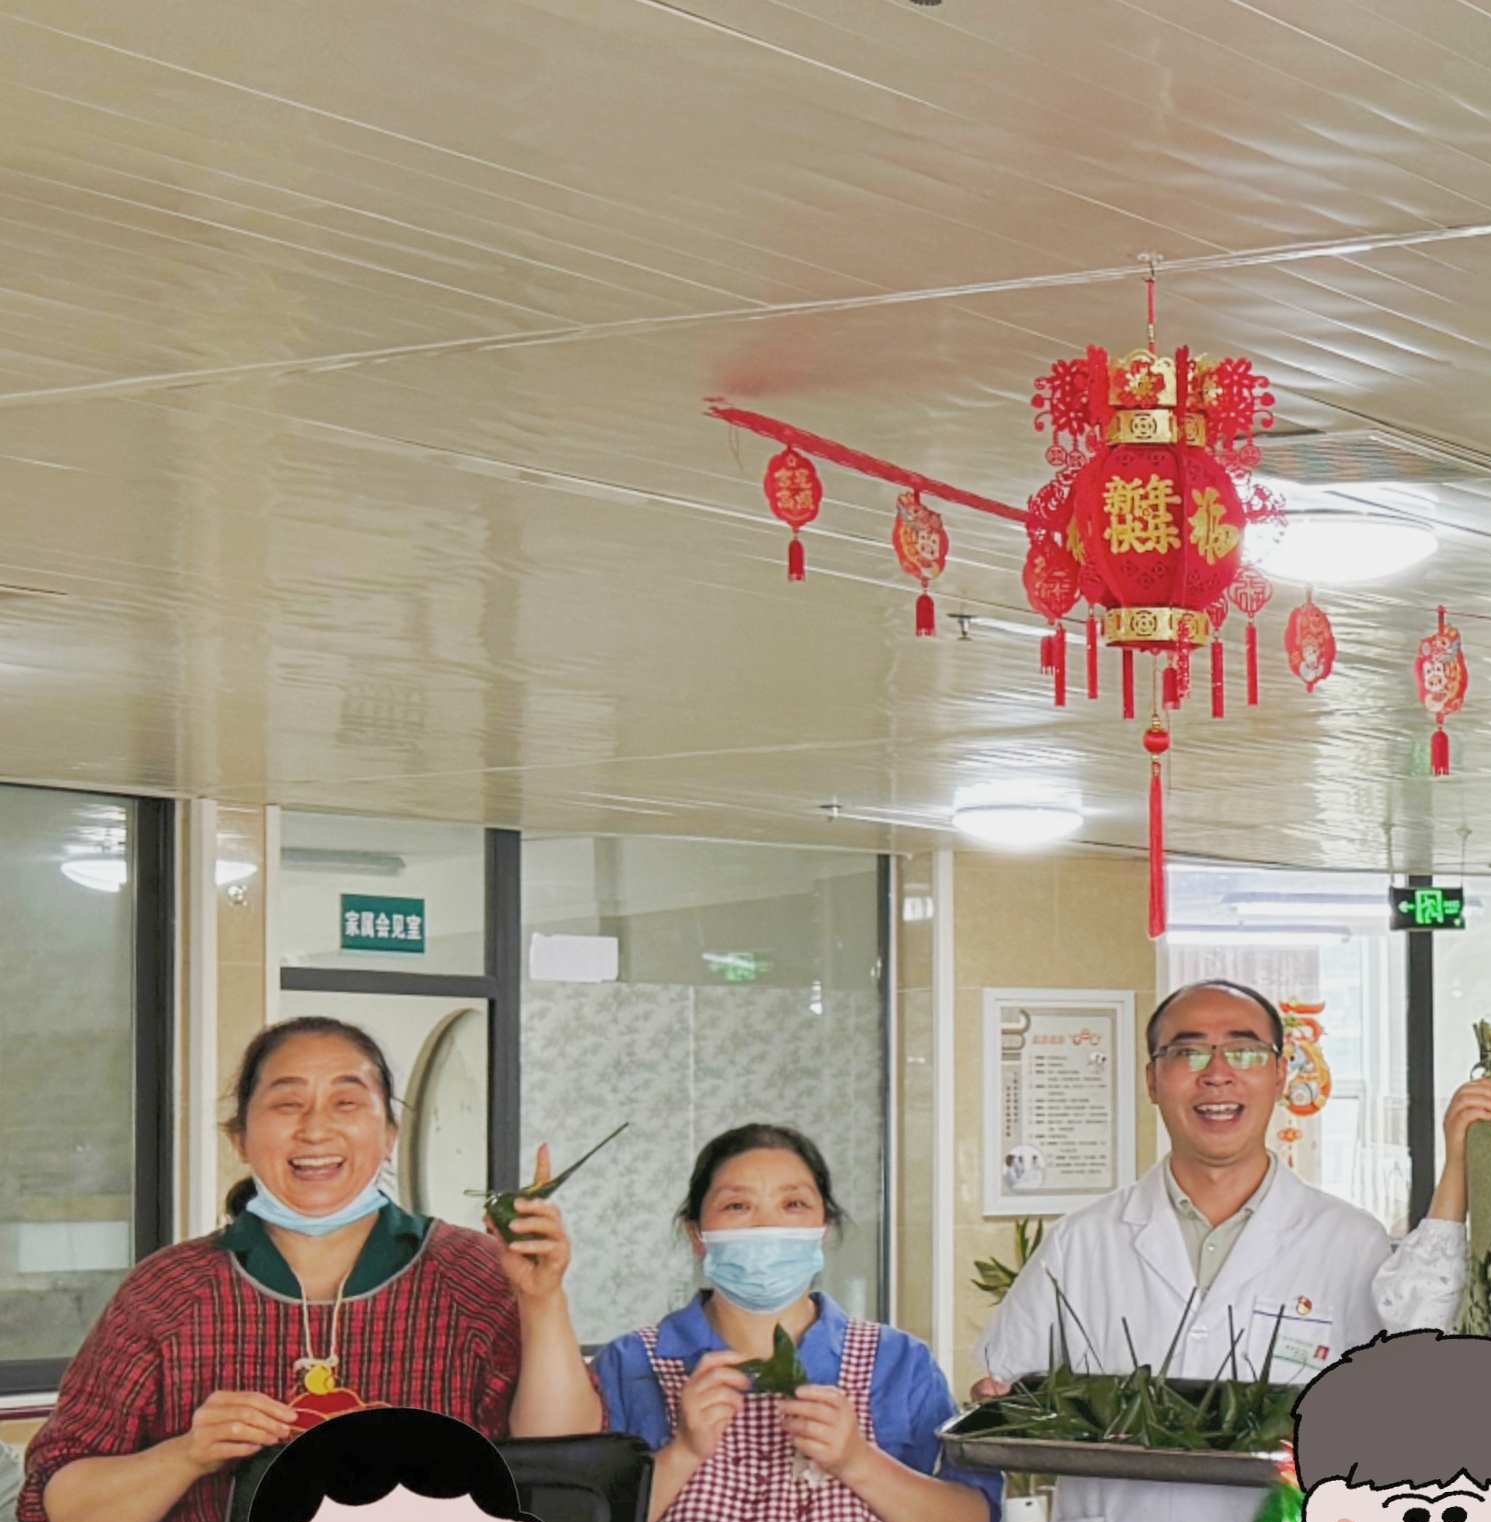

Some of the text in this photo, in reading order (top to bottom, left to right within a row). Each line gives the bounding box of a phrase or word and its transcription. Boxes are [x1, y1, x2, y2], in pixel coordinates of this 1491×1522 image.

[1103, 474, 1182, 516] 新年
[1103, 512, 1182, 554] 快乐
[1189, 486, 1241, 566] 福
[344, 909, 422, 941] 家属会见室
